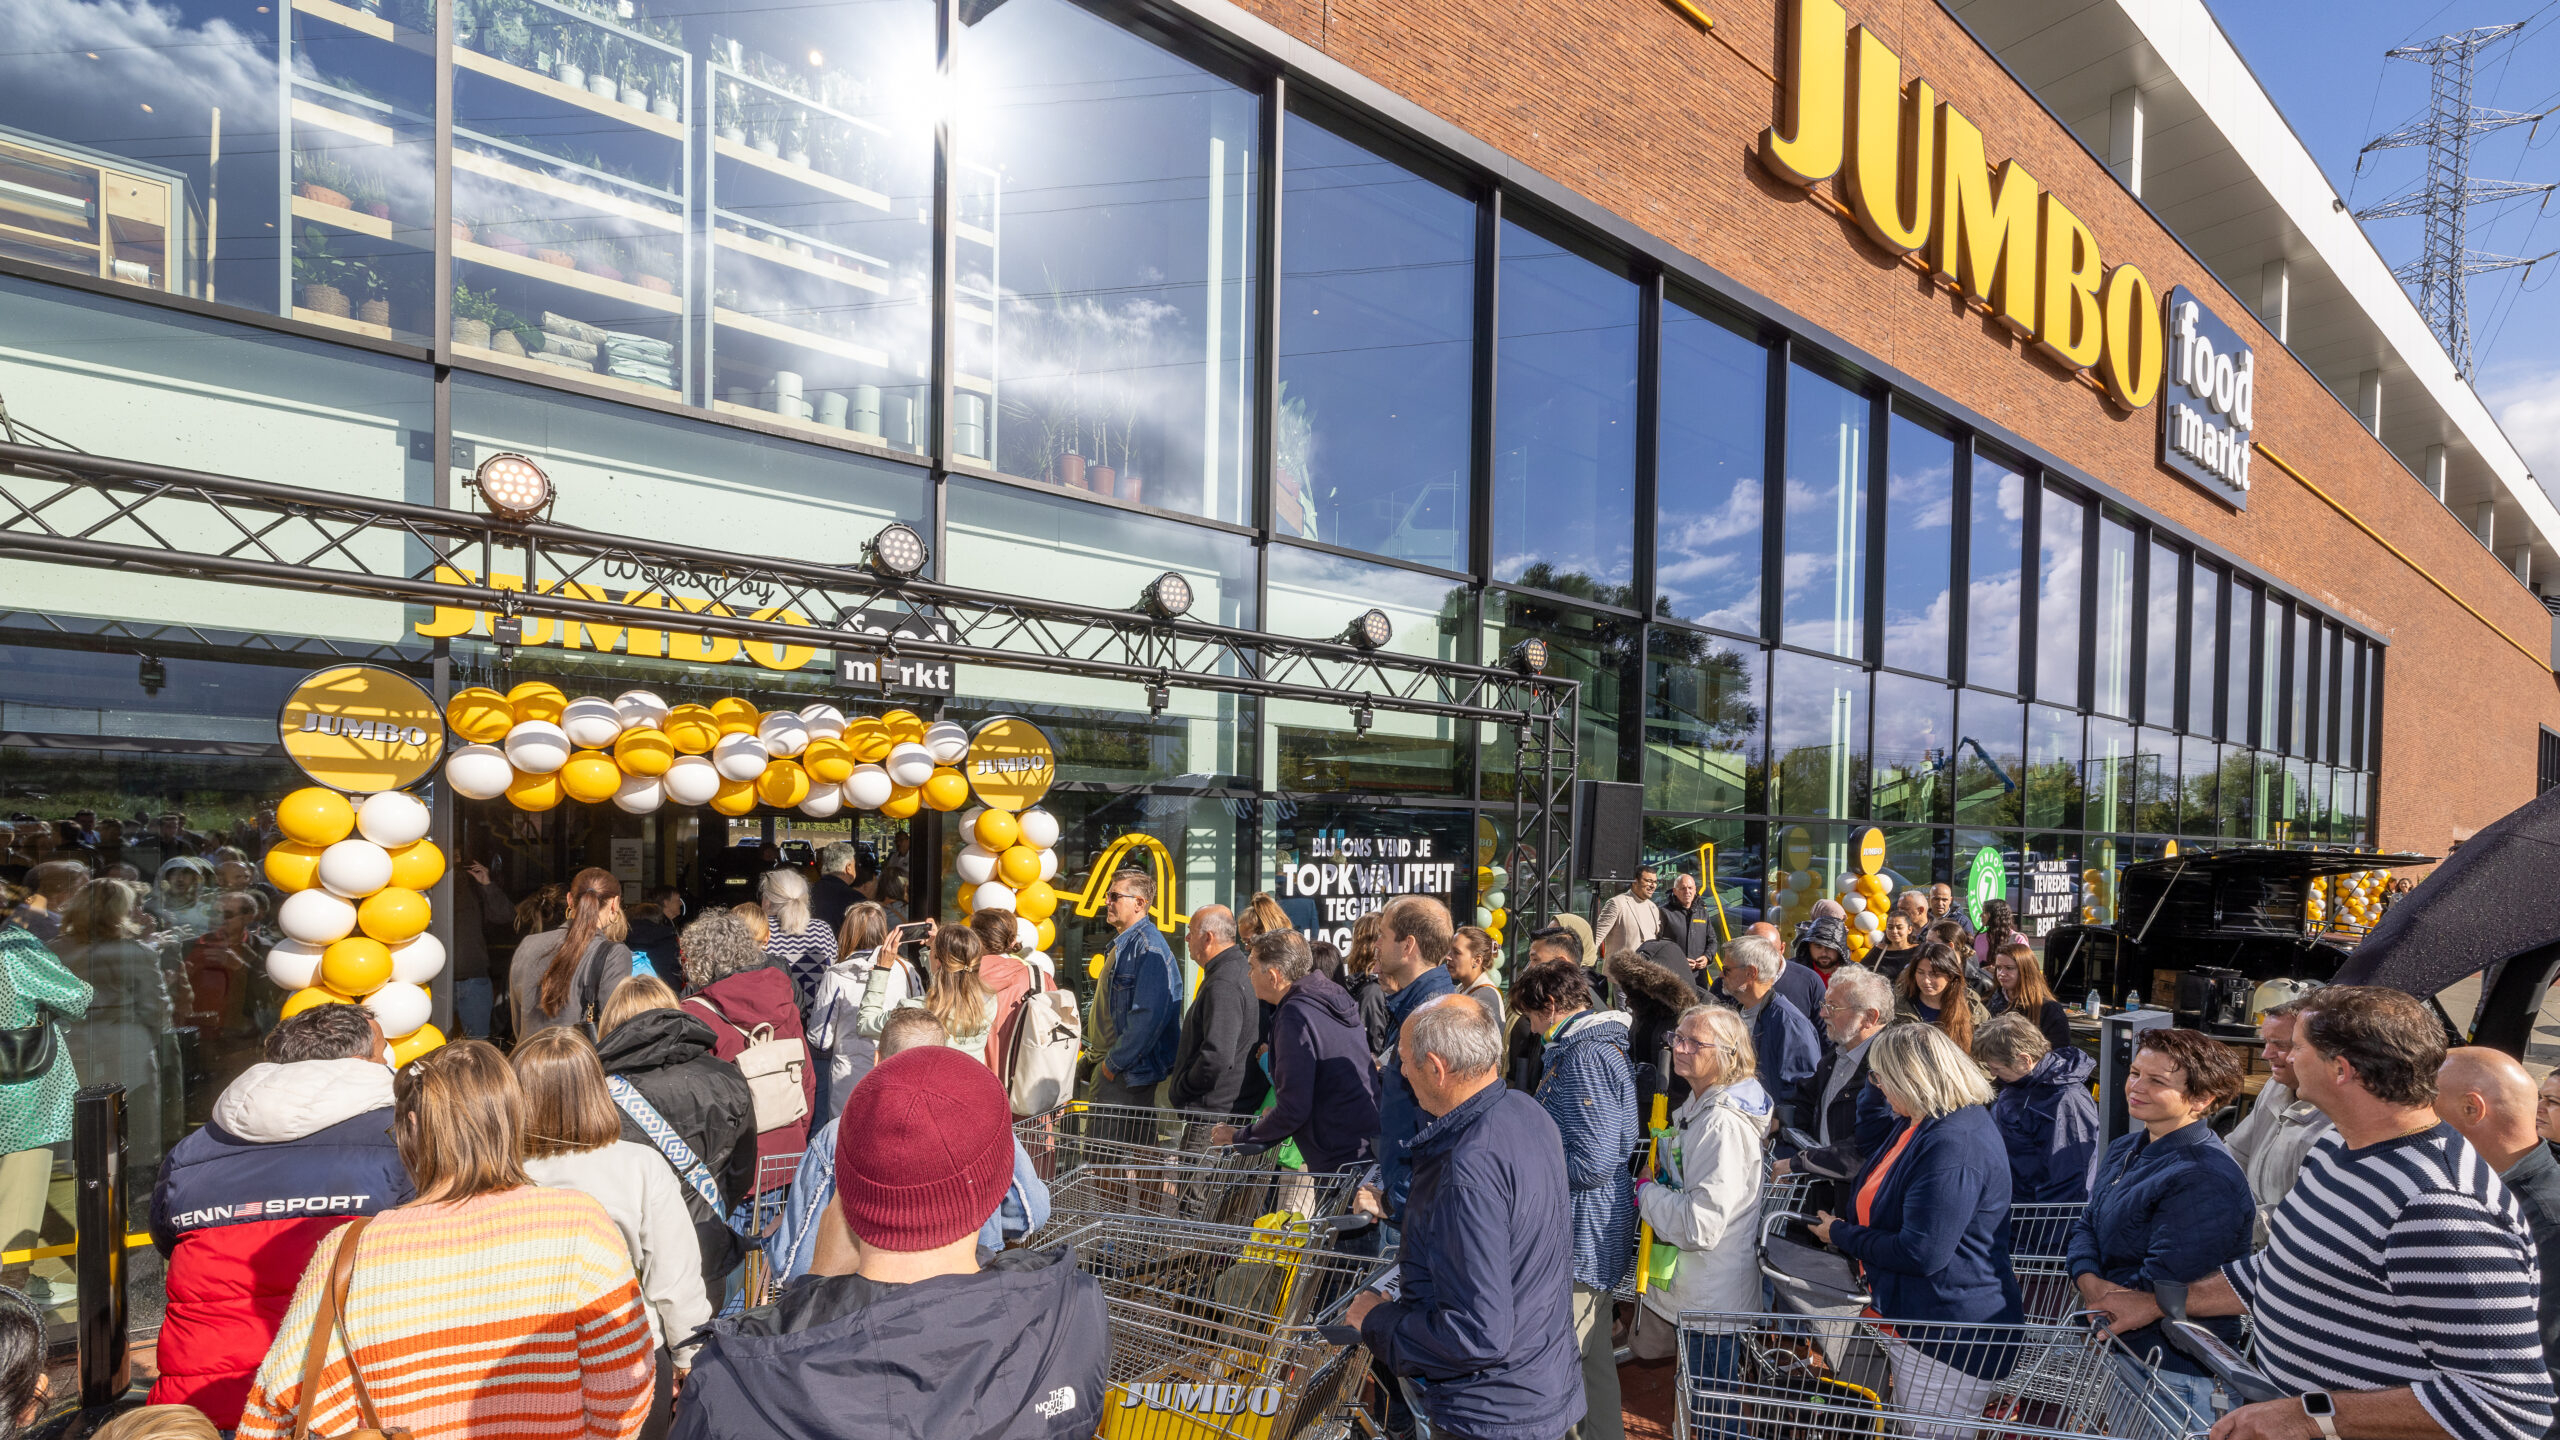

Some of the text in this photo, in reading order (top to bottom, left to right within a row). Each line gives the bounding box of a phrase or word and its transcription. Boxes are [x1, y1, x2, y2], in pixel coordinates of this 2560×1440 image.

[1758, 0, 2163, 411] JUMBO
[2174, 300, 2254, 431] food
[2173, 402, 2251, 491] markt
[414, 566, 817, 671] JUMBO
[843, 659, 950, 690] mrkt
[299, 693, 428, 747] JUMBO
[976, 755, 1046, 775] JUMBO
[1312, 837, 1431, 858] BIJ ONS VIND JE
[1283, 863, 1454, 896] TOPKWALITEIT
[1984, 875, 1993, 901] 7
[2034, 875, 2070, 893] TEVREDEN
[1326, 898, 1382, 922] TEGEN
[2029, 894, 2073, 914] ALS JIJ DAT
[265, 1195, 370, 1214] SPORT
[1035, 1398, 1064, 1414] NORTH
[1049, 1388, 1064, 1401] THE
[1120, 1383, 1282, 1417] JUMBO
[1045, 1406, 1065, 1420] FACE
